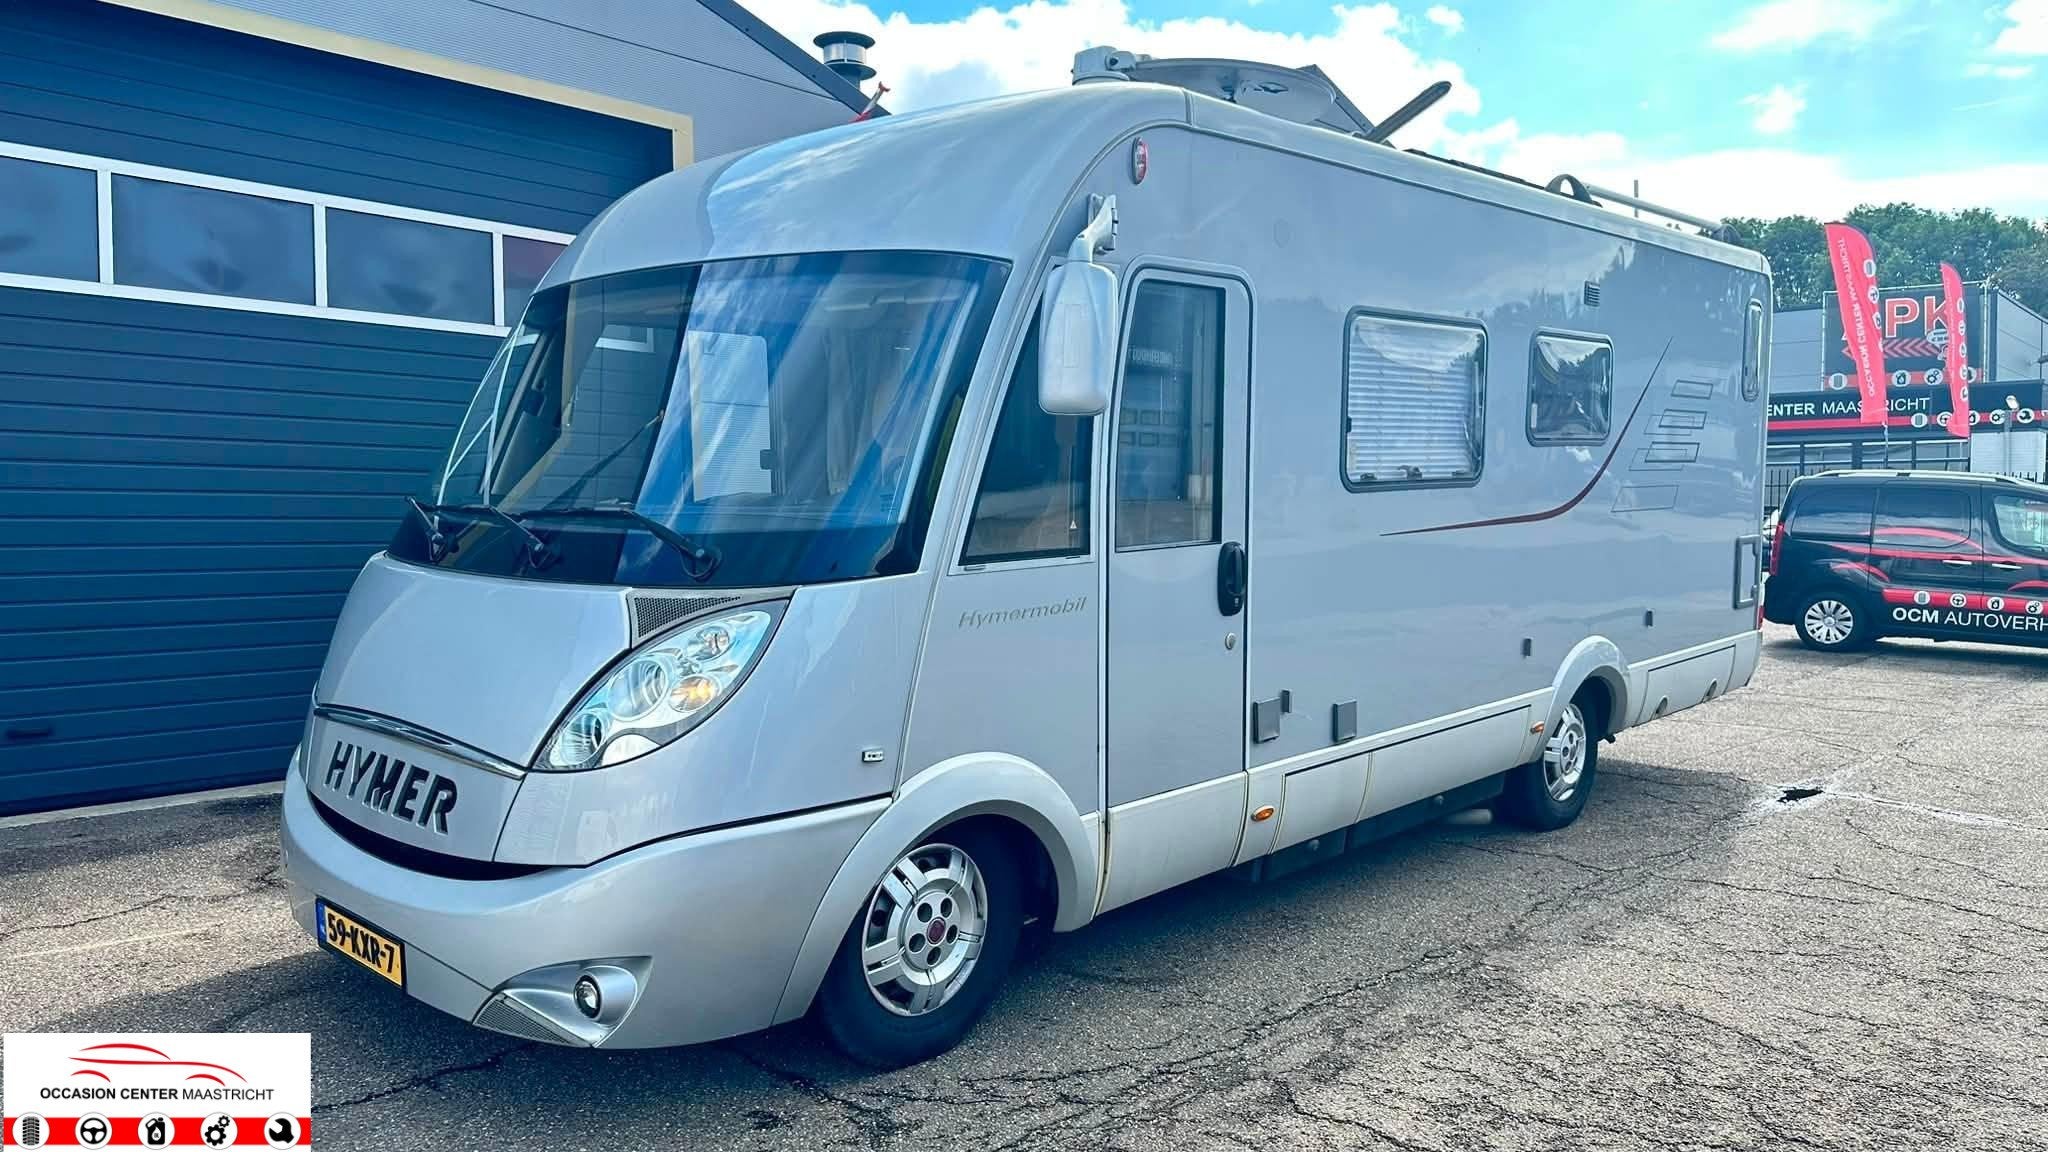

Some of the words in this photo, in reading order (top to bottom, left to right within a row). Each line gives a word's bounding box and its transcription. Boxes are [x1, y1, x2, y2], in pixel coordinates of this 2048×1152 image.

[1822, 398, 1930, 414] MAASICHT
[958, 596, 1087, 629] Hymermobil
[1892, 607, 1939, 623] OCM
[323, 740, 458, 836] HYMER
[327, 912, 395, 974] 59-KXR-7
